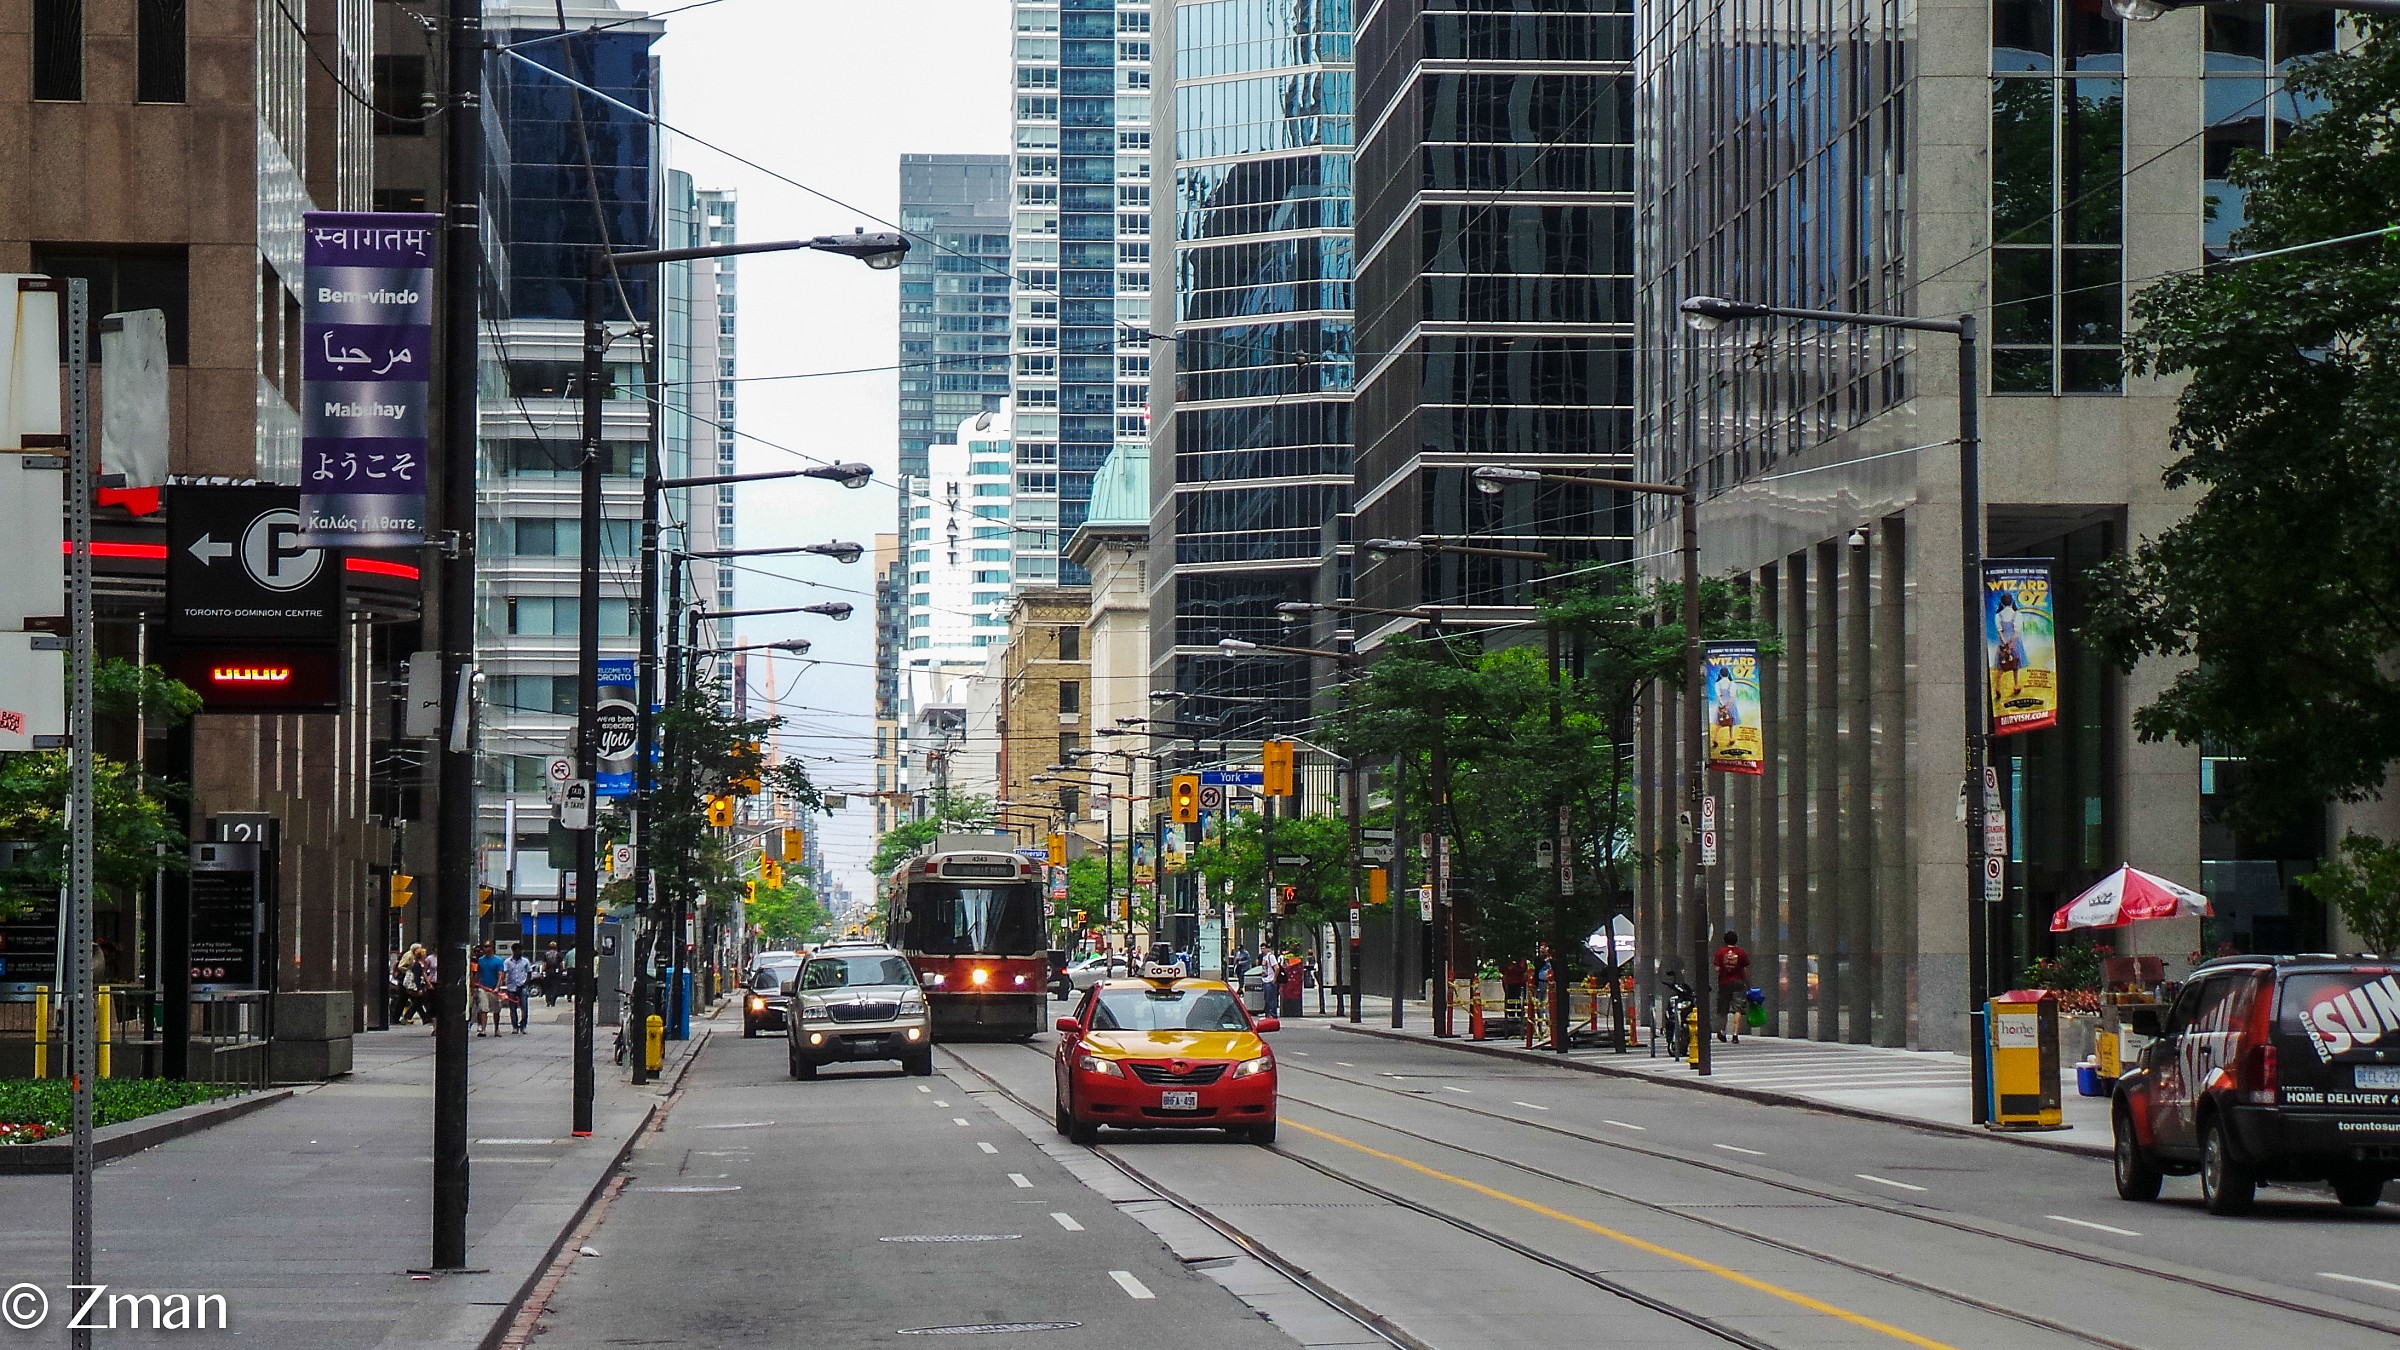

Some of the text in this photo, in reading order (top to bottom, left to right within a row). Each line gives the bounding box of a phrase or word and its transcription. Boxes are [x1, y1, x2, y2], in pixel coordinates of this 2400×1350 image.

[318, 287, 419, 305] Bem-vindo
[312, 452, 416, 481] ようこそ
[946, 481, 958, 565] HYATT
[1987, 580, 2048, 591] WIZARD
[2018, 591, 2048, 606] OZ
[184, 608, 323, 617] TORONTO-DOMINION CENTRE
[1709, 656, 1756, 666] WIZARD
[1732, 666, 1755, 678] OZ
[602, 723, 634, 731] expecting
[602, 731, 630, 752] you
[1220, 772, 1241, 782] York
[223, 823, 262, 842] 121
[1151, 967, 1180, 977] co-op
[2299, 1010, 2333, 1065] TORONTO
[2286, 1093, 2324, 1103] HOME
[2328, 1094, 2388, 1104] DELIVERY
